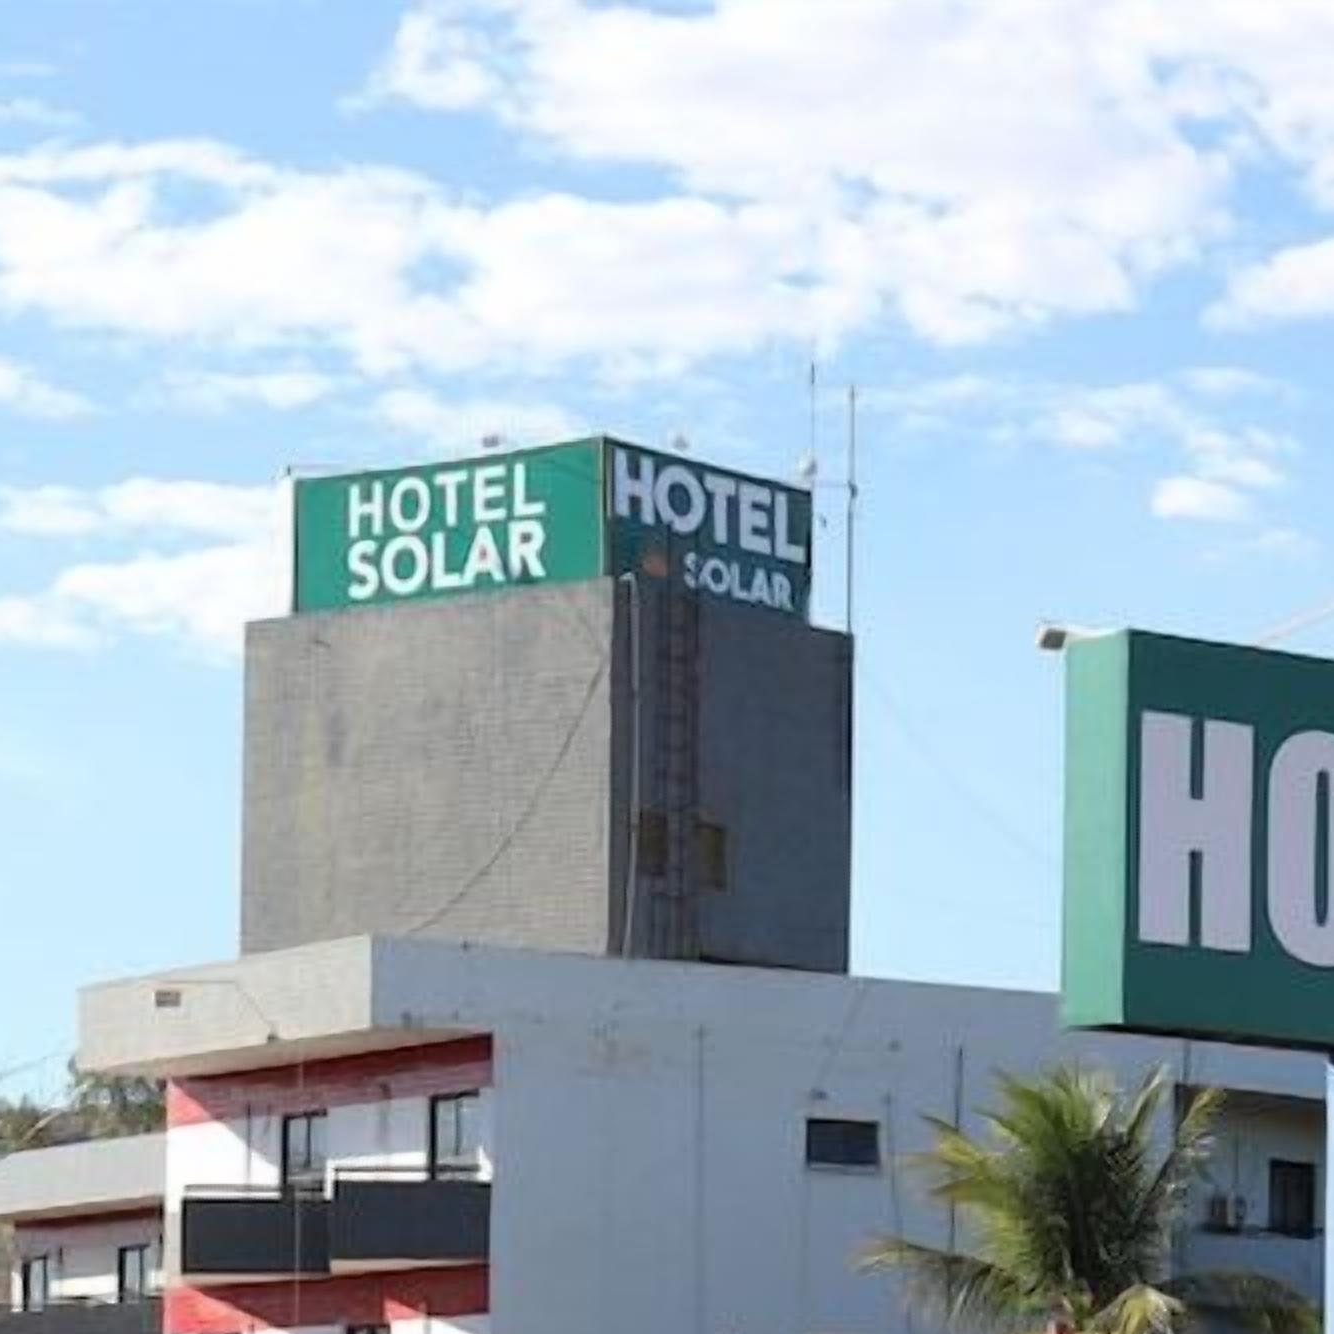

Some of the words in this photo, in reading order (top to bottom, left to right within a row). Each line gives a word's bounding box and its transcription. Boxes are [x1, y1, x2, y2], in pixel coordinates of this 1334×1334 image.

[348, 463, 544, 537] HOTEL
[613, 449, 806, 562] HOTEL
[348, 521, 546, 599] SOLAR
[683, 553, 793, 610] SOLAR
